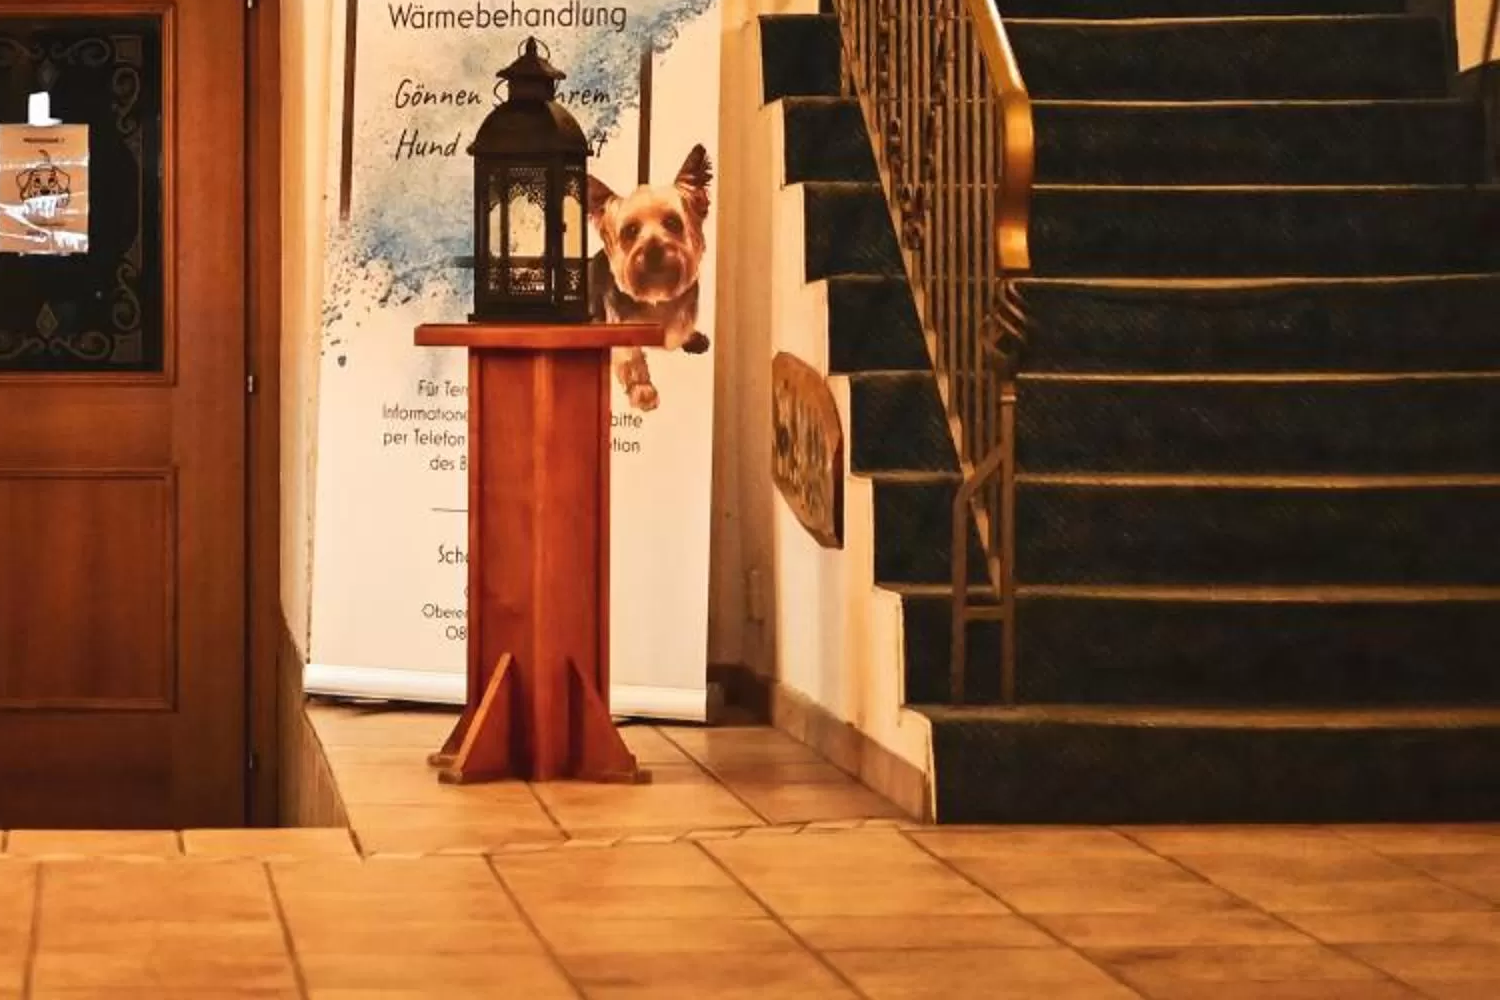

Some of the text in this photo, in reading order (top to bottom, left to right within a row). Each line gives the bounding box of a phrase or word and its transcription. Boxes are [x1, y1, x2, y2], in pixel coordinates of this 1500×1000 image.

[387, 0, 627, 32] Wärmebehandlung
[395, 78, 482, 109] Gönnen
[396, 129, 462, 161] Hund
[417, 379, 439, 397] Für
[383, 432, 408, 446] per
[414, 428, 465, 446] Telefon
[429, 454, 455, 471] des
